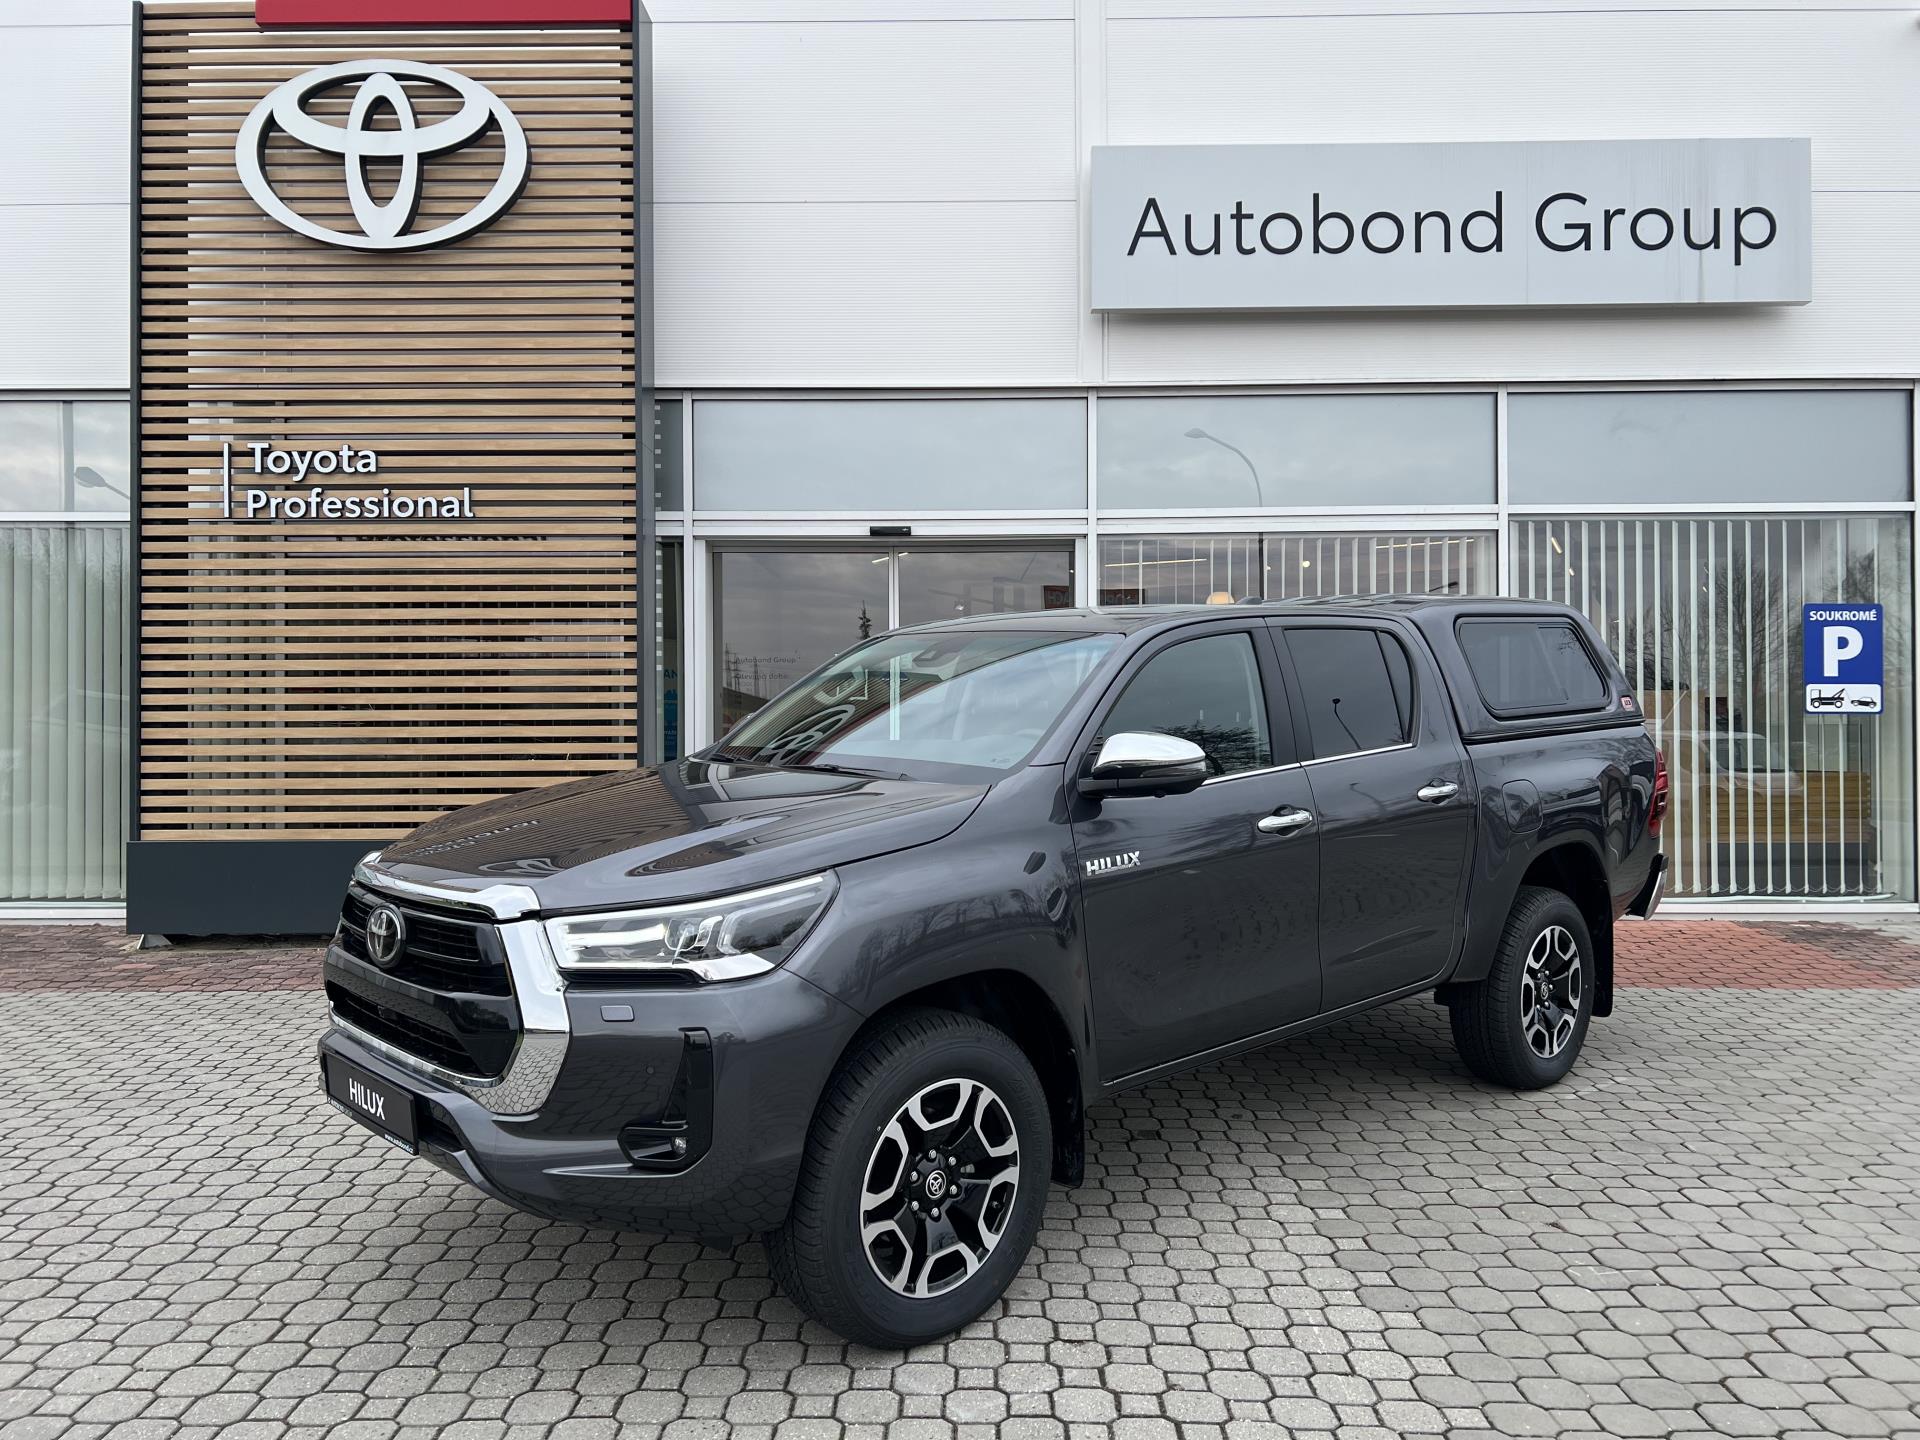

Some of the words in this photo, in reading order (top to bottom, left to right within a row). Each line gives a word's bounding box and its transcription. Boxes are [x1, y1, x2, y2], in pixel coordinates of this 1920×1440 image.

[1127, 190, 1503, 256] Autobond
[1535, 192, 1777, 266] Group
[247, 442, 378, 481] Toyota
[247, 487, 475, 519] Professional
[1809, 609, 1878, 621] SOUKROMÉ
[1823, 625, 1864, 677] P
[1086, 851, 1140, 876] HILUX
[349, 1078, 386, 1121] HILUX
